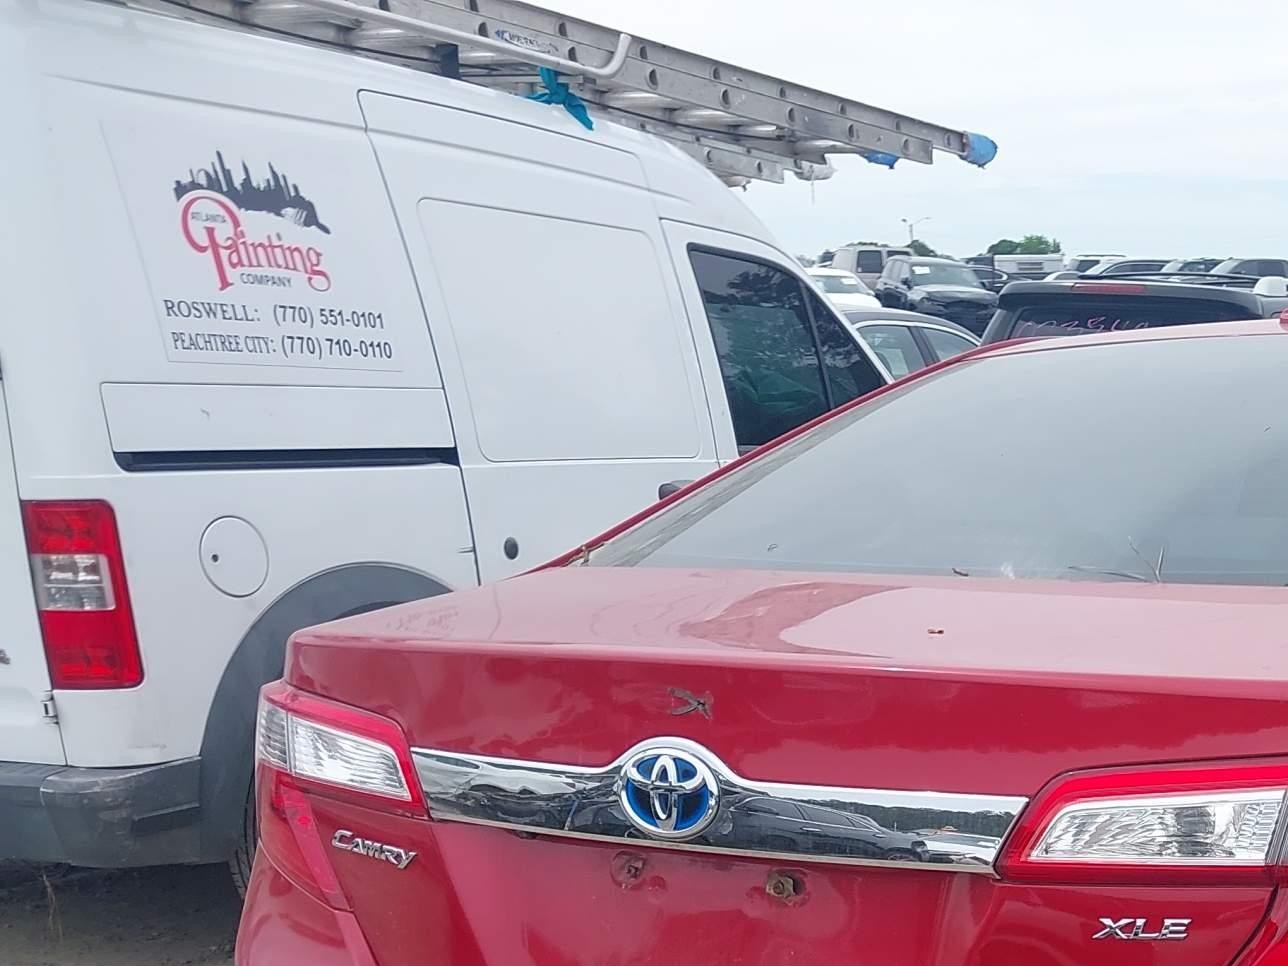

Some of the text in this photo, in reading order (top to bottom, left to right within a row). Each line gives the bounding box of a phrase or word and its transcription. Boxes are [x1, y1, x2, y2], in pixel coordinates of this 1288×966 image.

[181, 195, 331, 292] Painting
[240, 273, 292, 287] COMPANY
[163, 299, 385, 329] ROSWELL: (770) 551-0101
[171, 331, 393, 359] PEACHTREE CITY: (770) 710-0110
[1092, 917, 1192, 940] XLE
